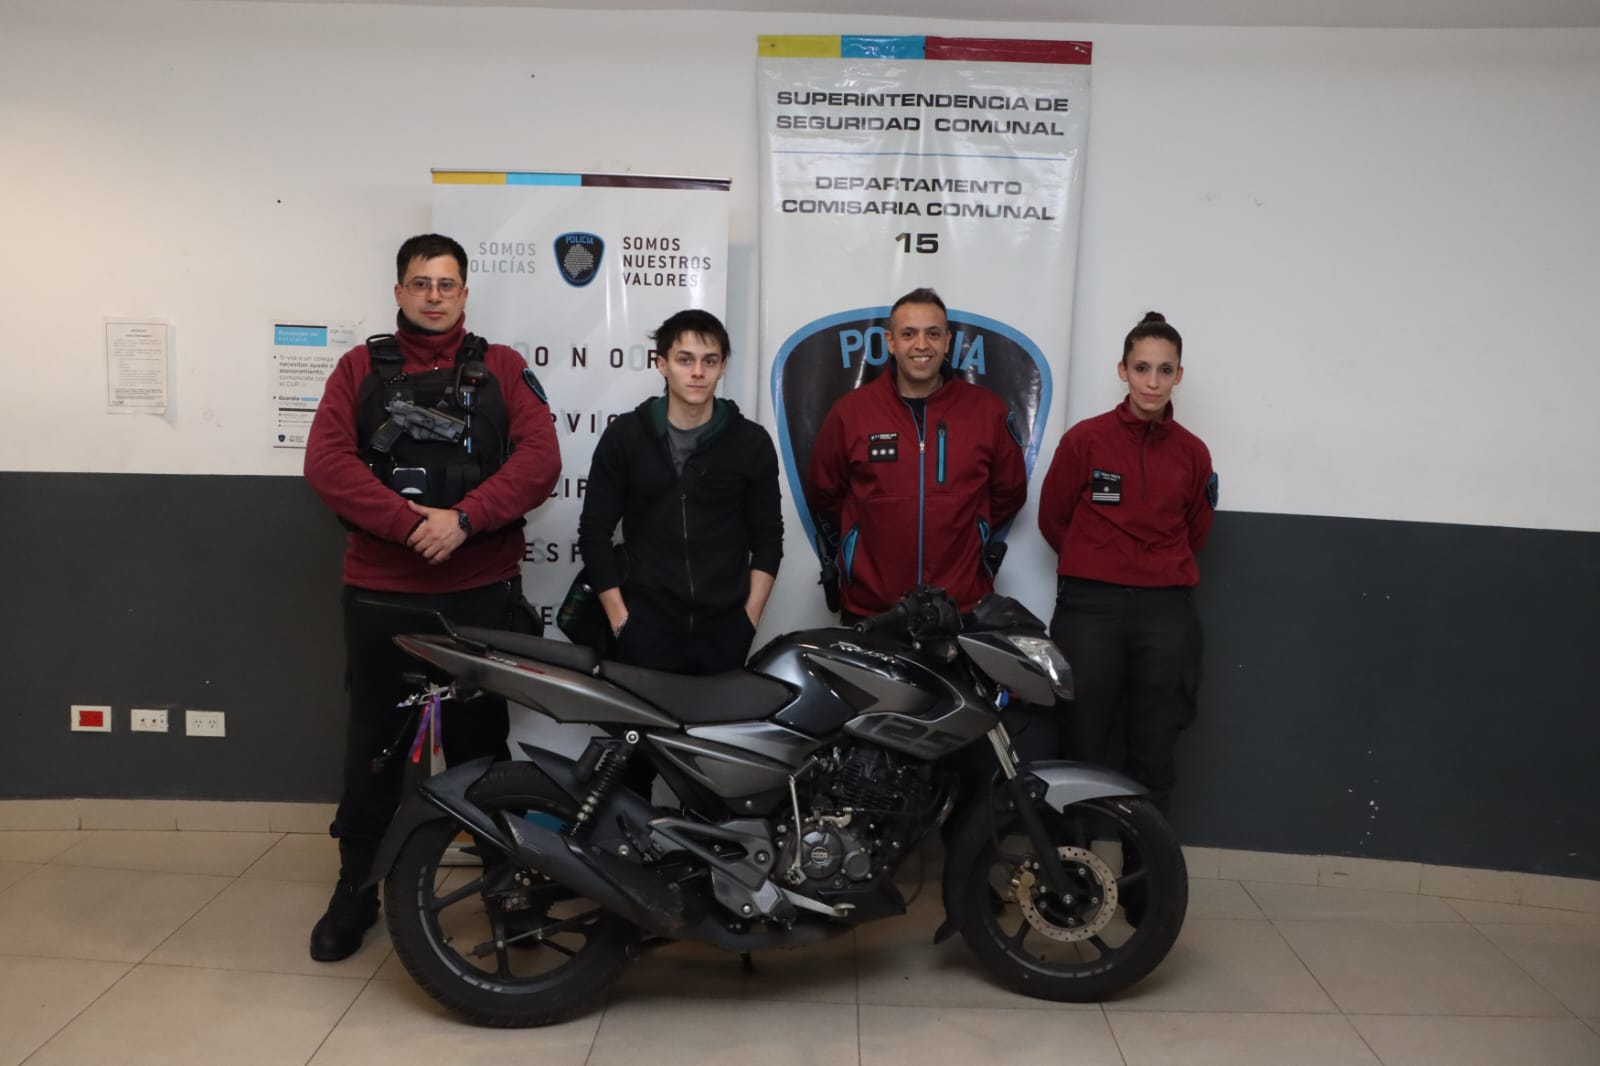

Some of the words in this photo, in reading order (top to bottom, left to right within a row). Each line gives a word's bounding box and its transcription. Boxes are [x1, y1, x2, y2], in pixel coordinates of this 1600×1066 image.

[777, 91, 1029, 111] SUPERINTENDENCIA
[1035, 97, 1069, 113] DE
[776, 115, 921, 131] SEGURIDAD
[934, 117, 1064, 136] COMUNAL
[815, 176, 1022, 195] DEPARTAMENTO
[782, 200, 921, 216] COMISARIA
[926, 202, 1055, 221] COMUNAL
[479, 242, 537, 257] SOMOS
[622, 236, 681, 251] SOMOS
[895, 232, 939, 254] 15
[469, 257, 536, 275] OLICÍAS
[622, 255, 712, 270] NUESTROS
[622, 272, 699, 287] VALORES
[839, 326, 986, 375] POIA
